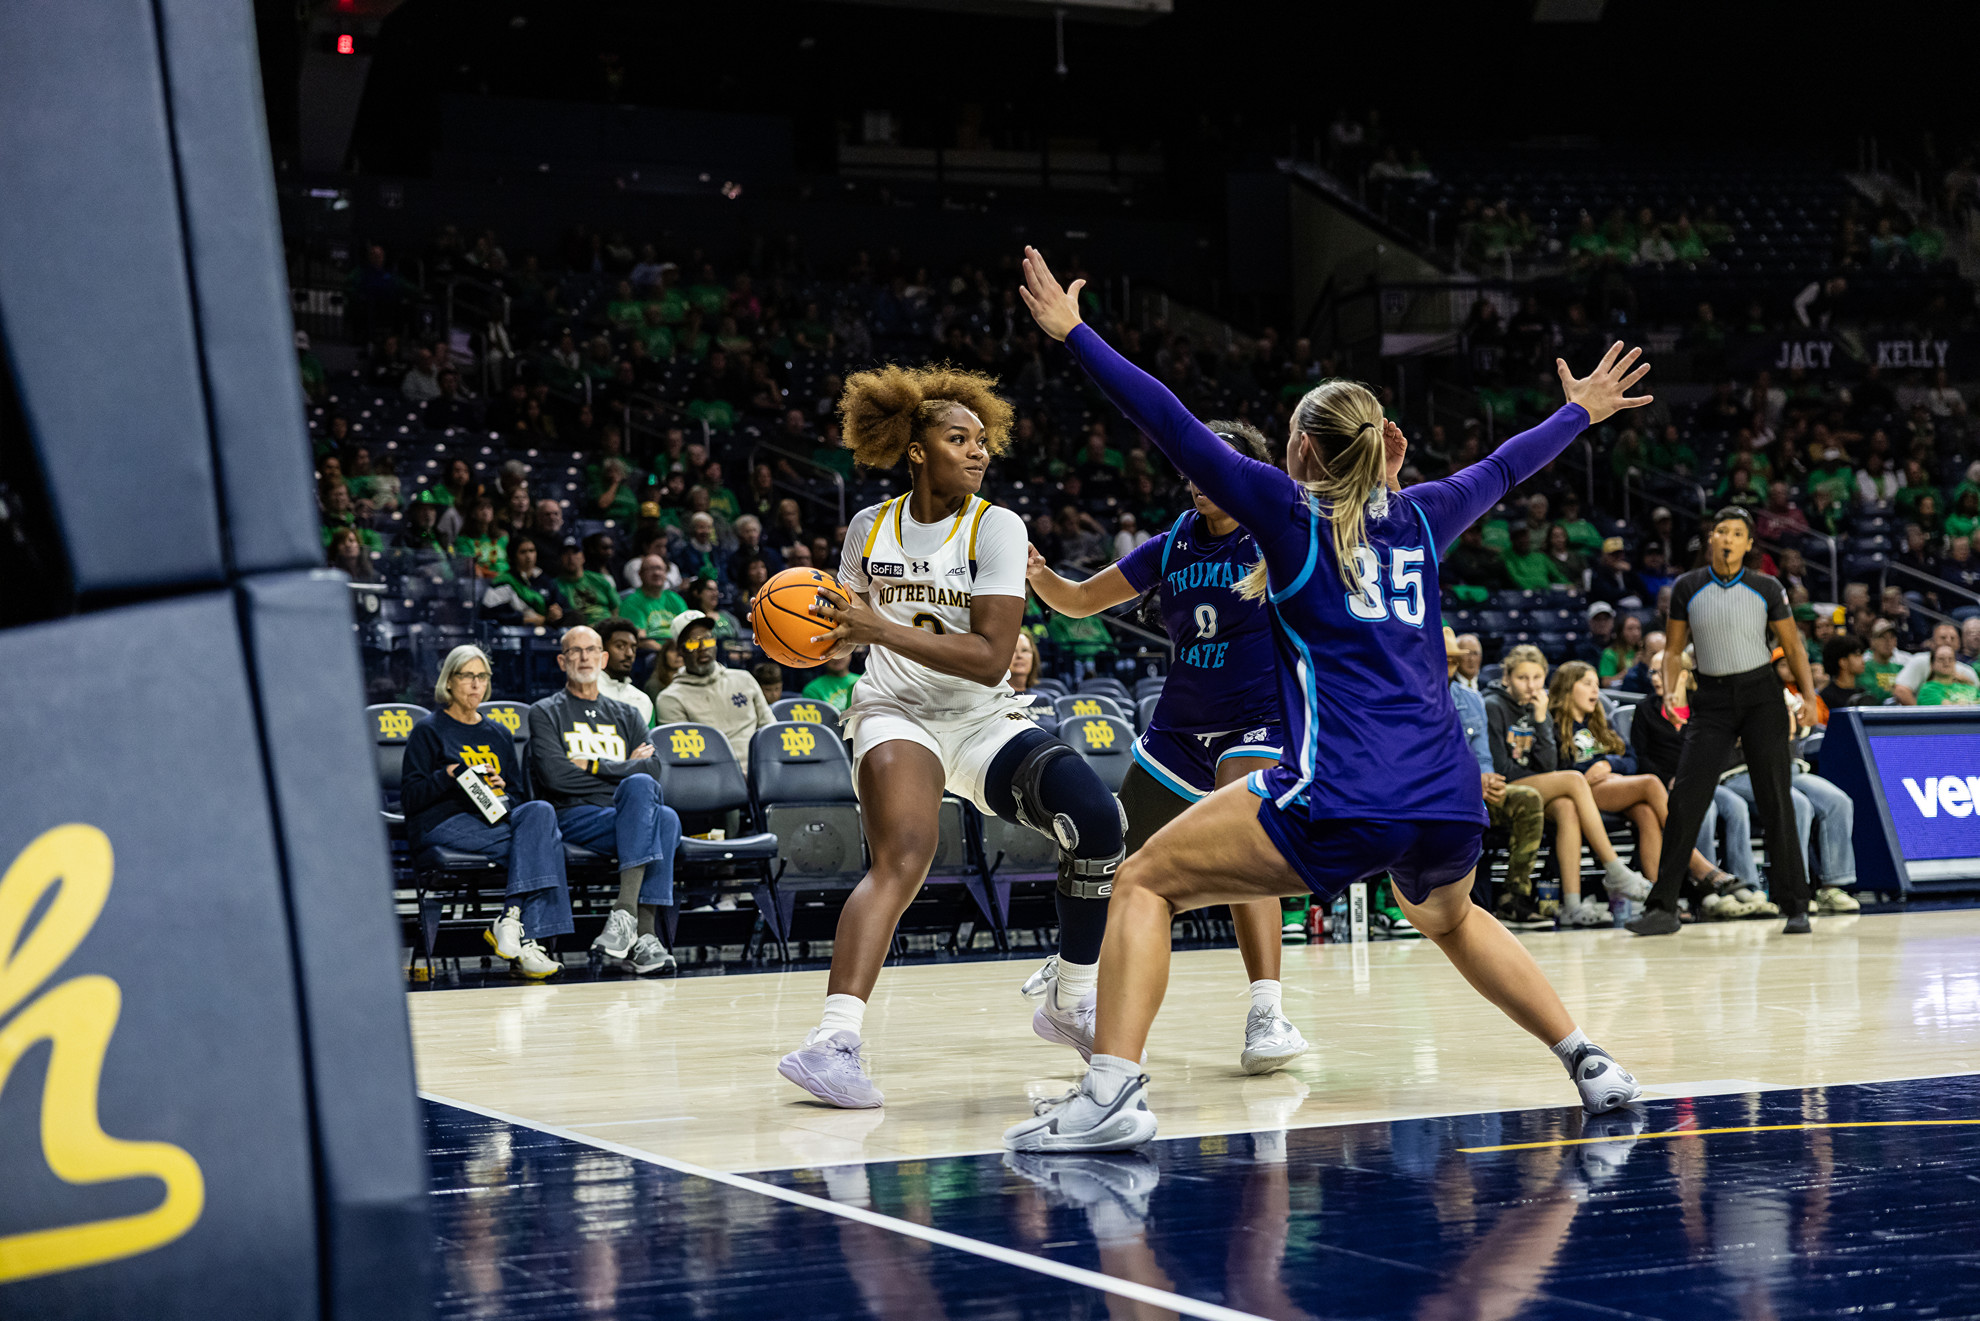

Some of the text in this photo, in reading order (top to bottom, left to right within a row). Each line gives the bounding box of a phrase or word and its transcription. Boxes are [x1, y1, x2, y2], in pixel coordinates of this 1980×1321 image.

[1775, 339, 1948, 369] JACY KELLY
[872, 563, 892, 575] SoFi
[878, 583, 971, 609] NOTRE DAME
[1343, 542, 1426, 629] 35
[1193, 602, 1218, 640] 0
[468, 782, 493, 811] POPCORN
[1901, 775, 1980, 818] ver
